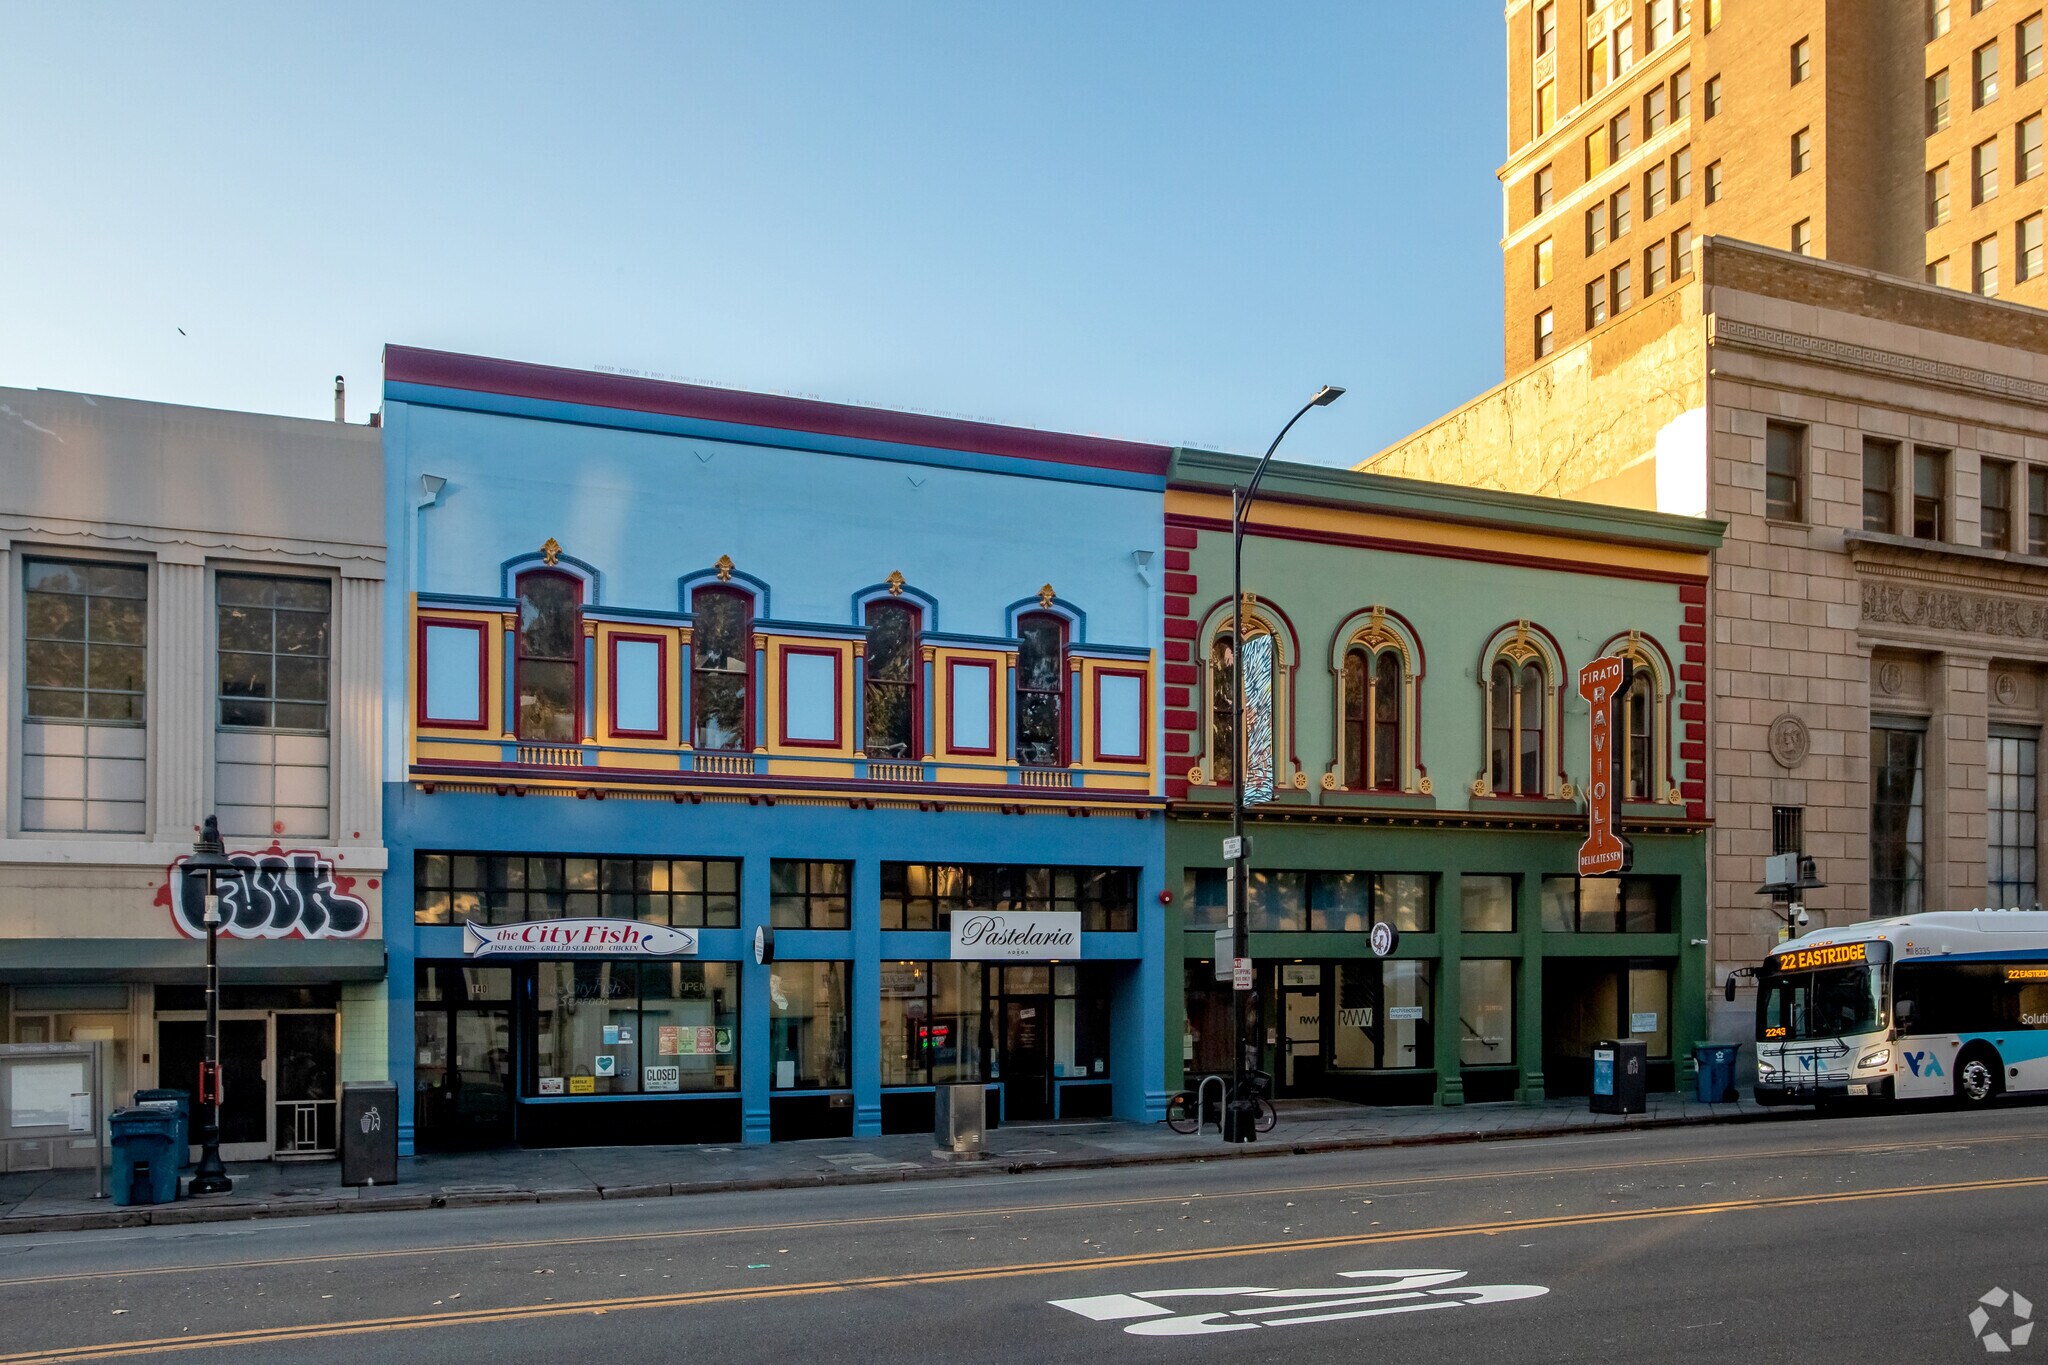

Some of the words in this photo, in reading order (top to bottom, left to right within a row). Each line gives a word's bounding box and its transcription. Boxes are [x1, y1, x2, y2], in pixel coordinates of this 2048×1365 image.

[1582, 664, 1620, 685] FIRATO
[1593, 686, 1607, 848] RAVIOLI
[1581, 851, 1621, 865] DELICATESSEN
[497, 930, 518, 941] the
[521, 925, 580, 945] City
[583, 925, 640, 944] Fish
[961, 916, 1075, 945] Pastelaria
[1780, 955, 1797, 970] 22
[1798, 943, 1867, 968] EASTRIDGE
[1915, 947, 1931, 955] 8335
[2008, 969, 2020, 979] 22
[472, 984, 487, 993] 140
[680, 981, 706, 991] OPEN
[1765, 1027, 1787, 1038] 2243
[646, 1068, 677, 1081] CLOSED
